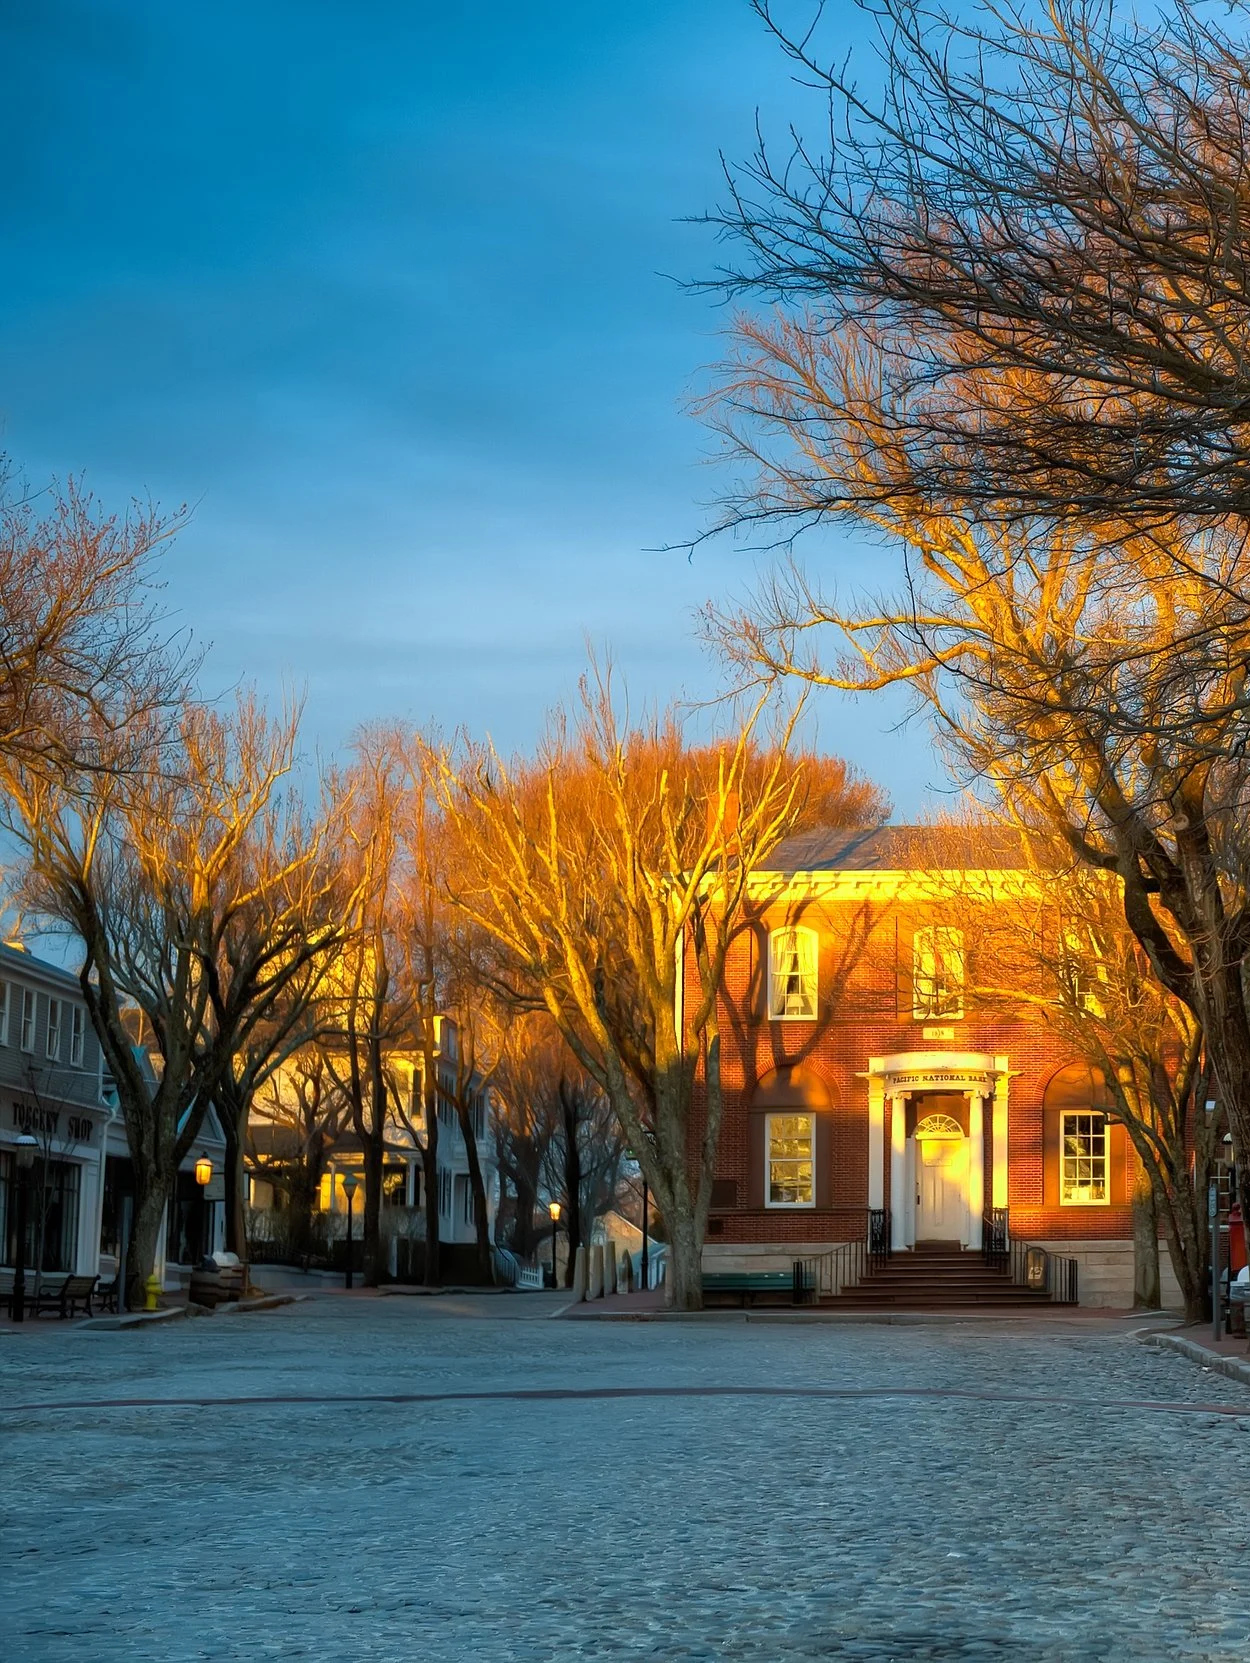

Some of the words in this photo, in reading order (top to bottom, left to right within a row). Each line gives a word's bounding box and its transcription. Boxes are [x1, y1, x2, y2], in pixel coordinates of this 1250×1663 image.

[892, 1075, 919, 1084] PACIFIC
[922, 1074, 966, 1082] NATIONAL
[968, 1075, 988, 1083] BANK
[68, 1115, 94, 1141] SHOP
